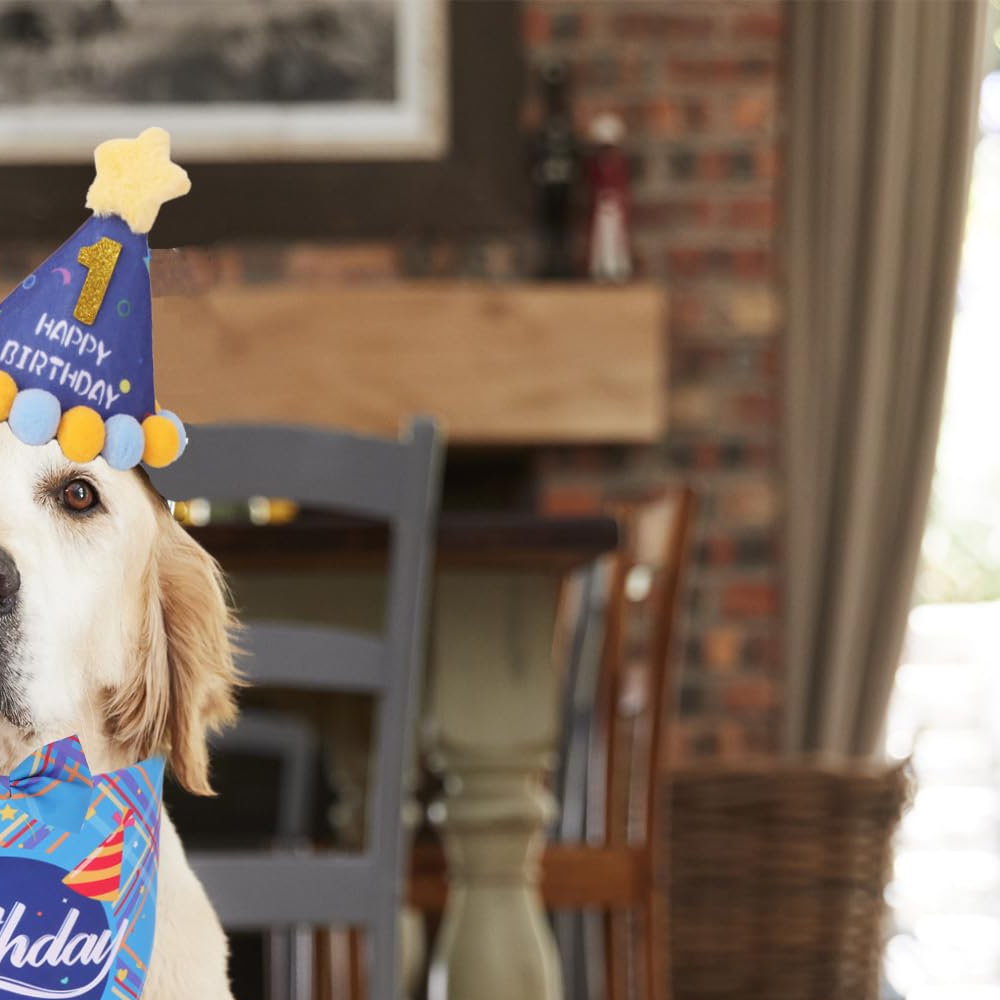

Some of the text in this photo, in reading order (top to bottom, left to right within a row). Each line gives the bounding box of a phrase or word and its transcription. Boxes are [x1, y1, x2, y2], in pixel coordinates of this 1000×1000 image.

[73, 236, 123, 326] 1
[34, 312, 112, 366] HAPPY
[0, 340, 121, 410] BIRTHDAY
